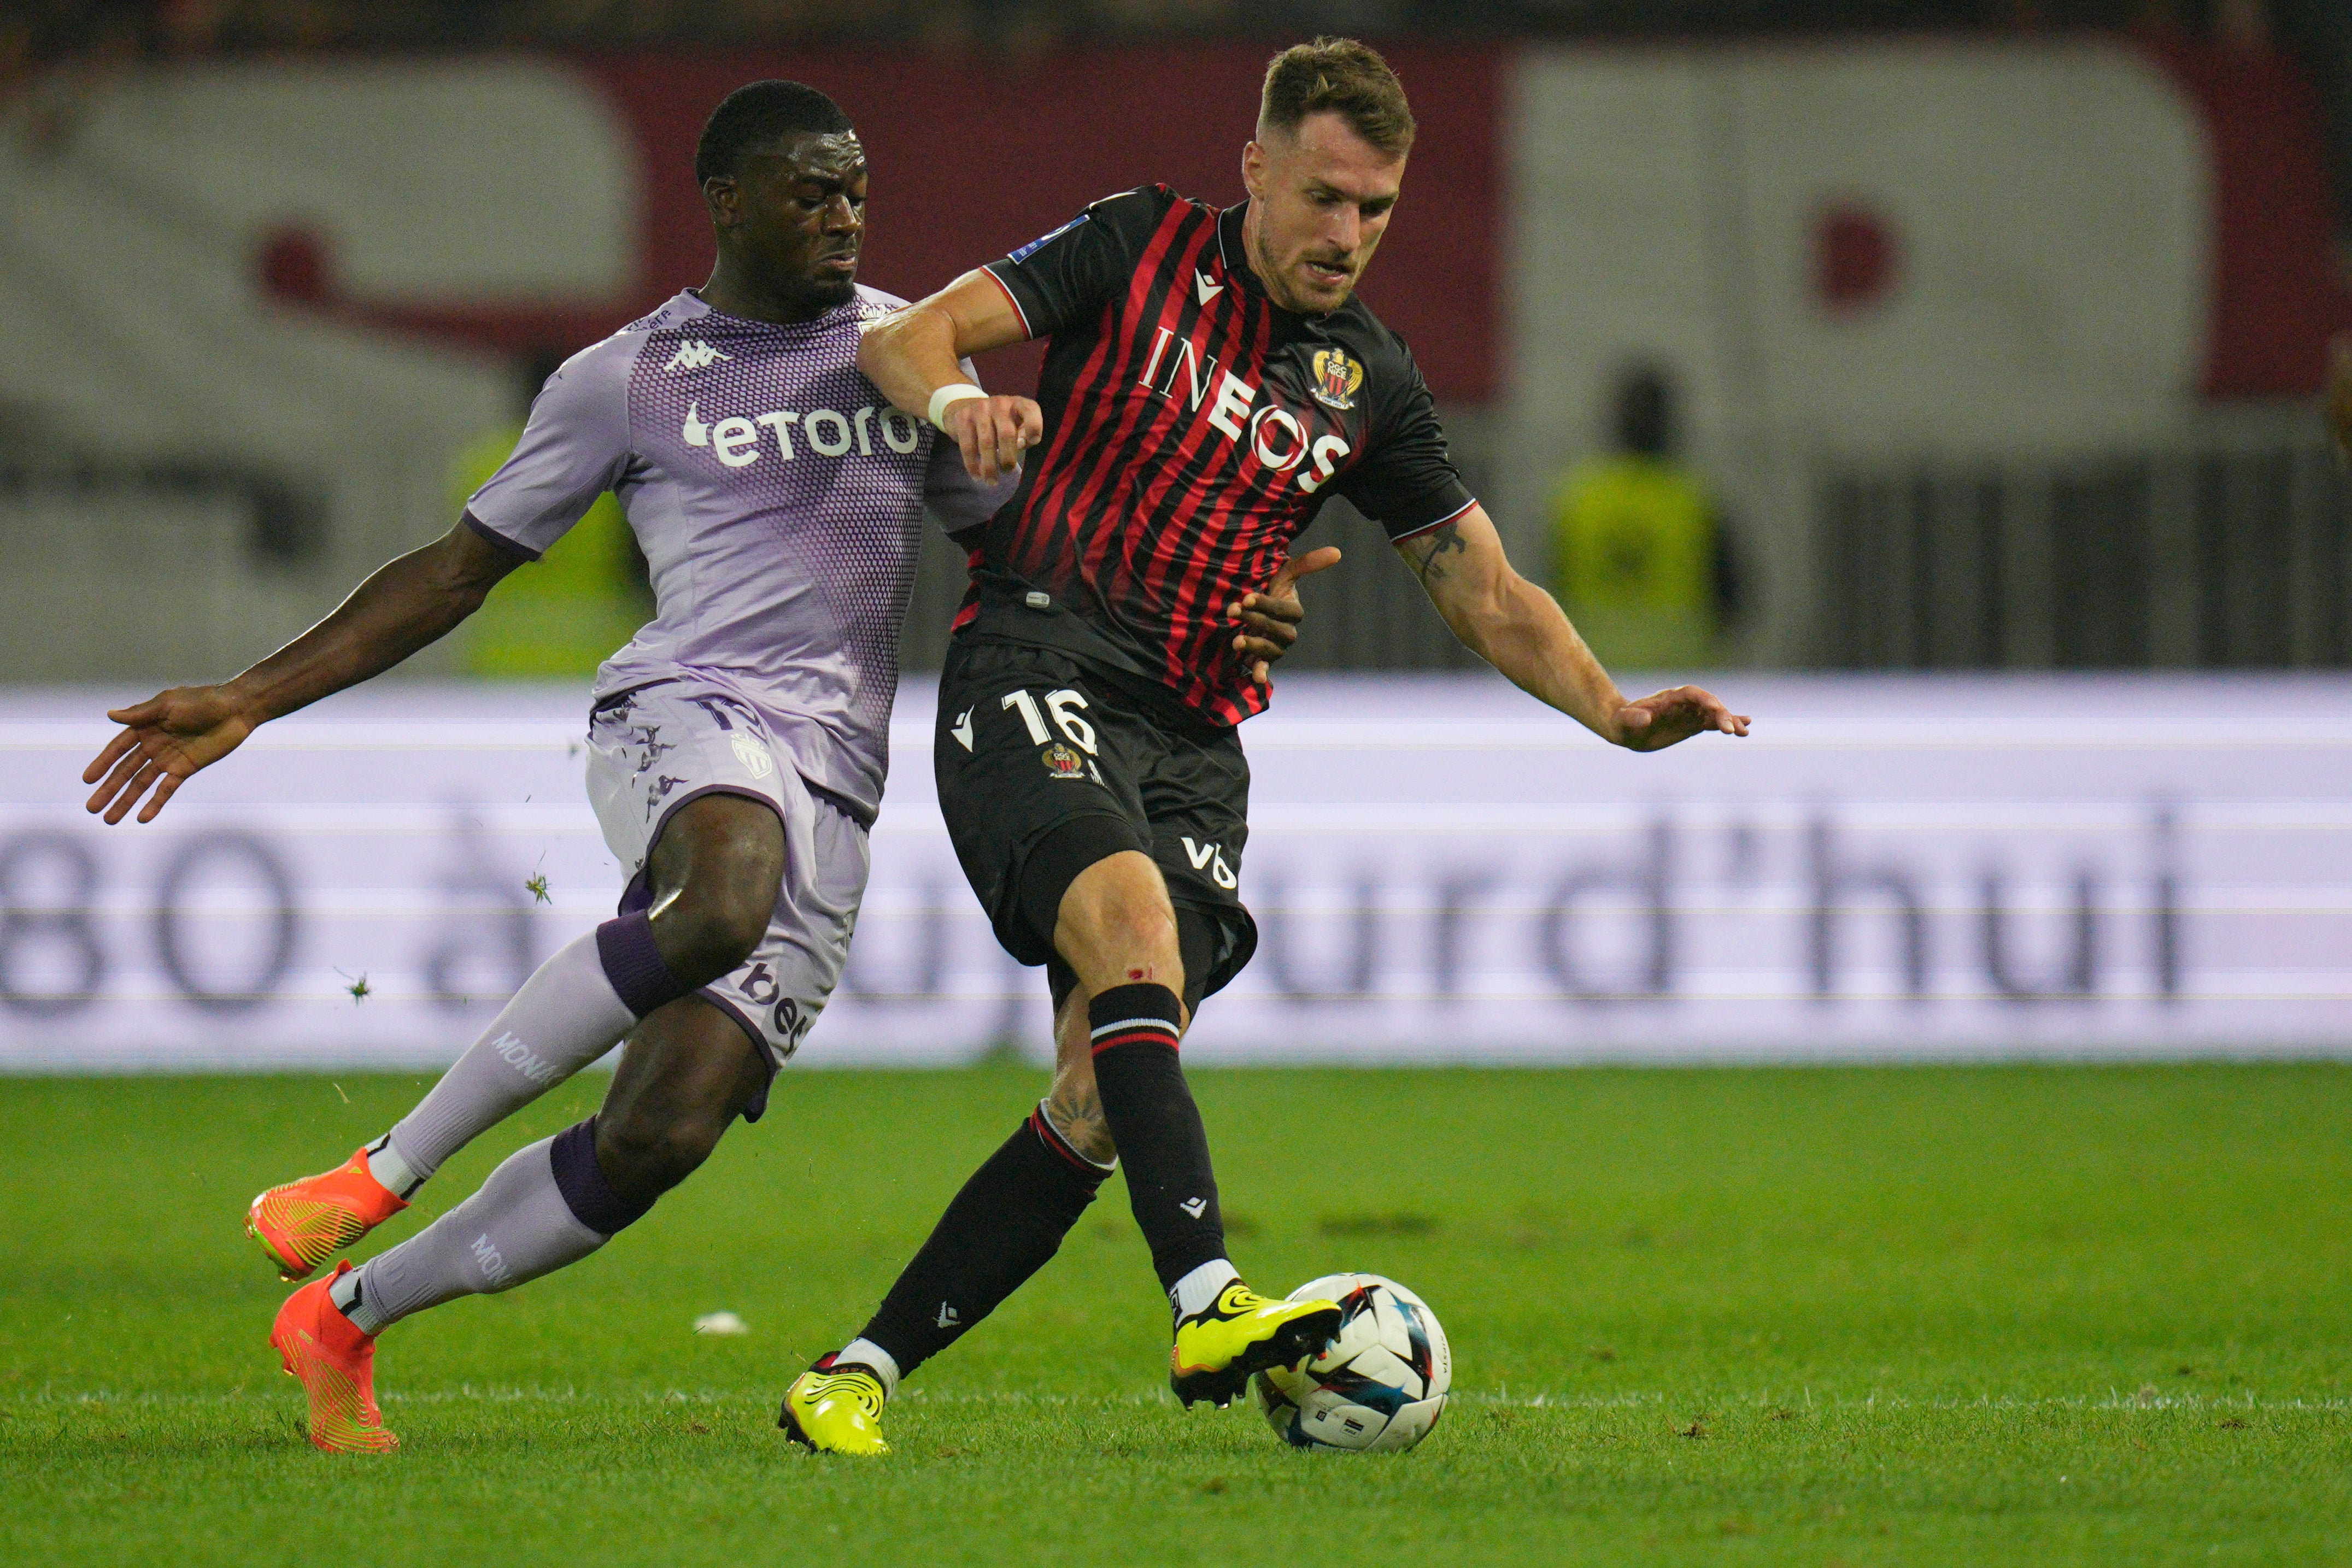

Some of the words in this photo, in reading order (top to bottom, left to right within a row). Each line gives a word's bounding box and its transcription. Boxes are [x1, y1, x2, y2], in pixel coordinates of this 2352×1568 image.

[1327, 367, 1347, 380] NICE
[1328, 361, 1347, 373] OGC
[1139, 326, 1350, 493] INEOS
[1001, 689, 1099, 756] 16
